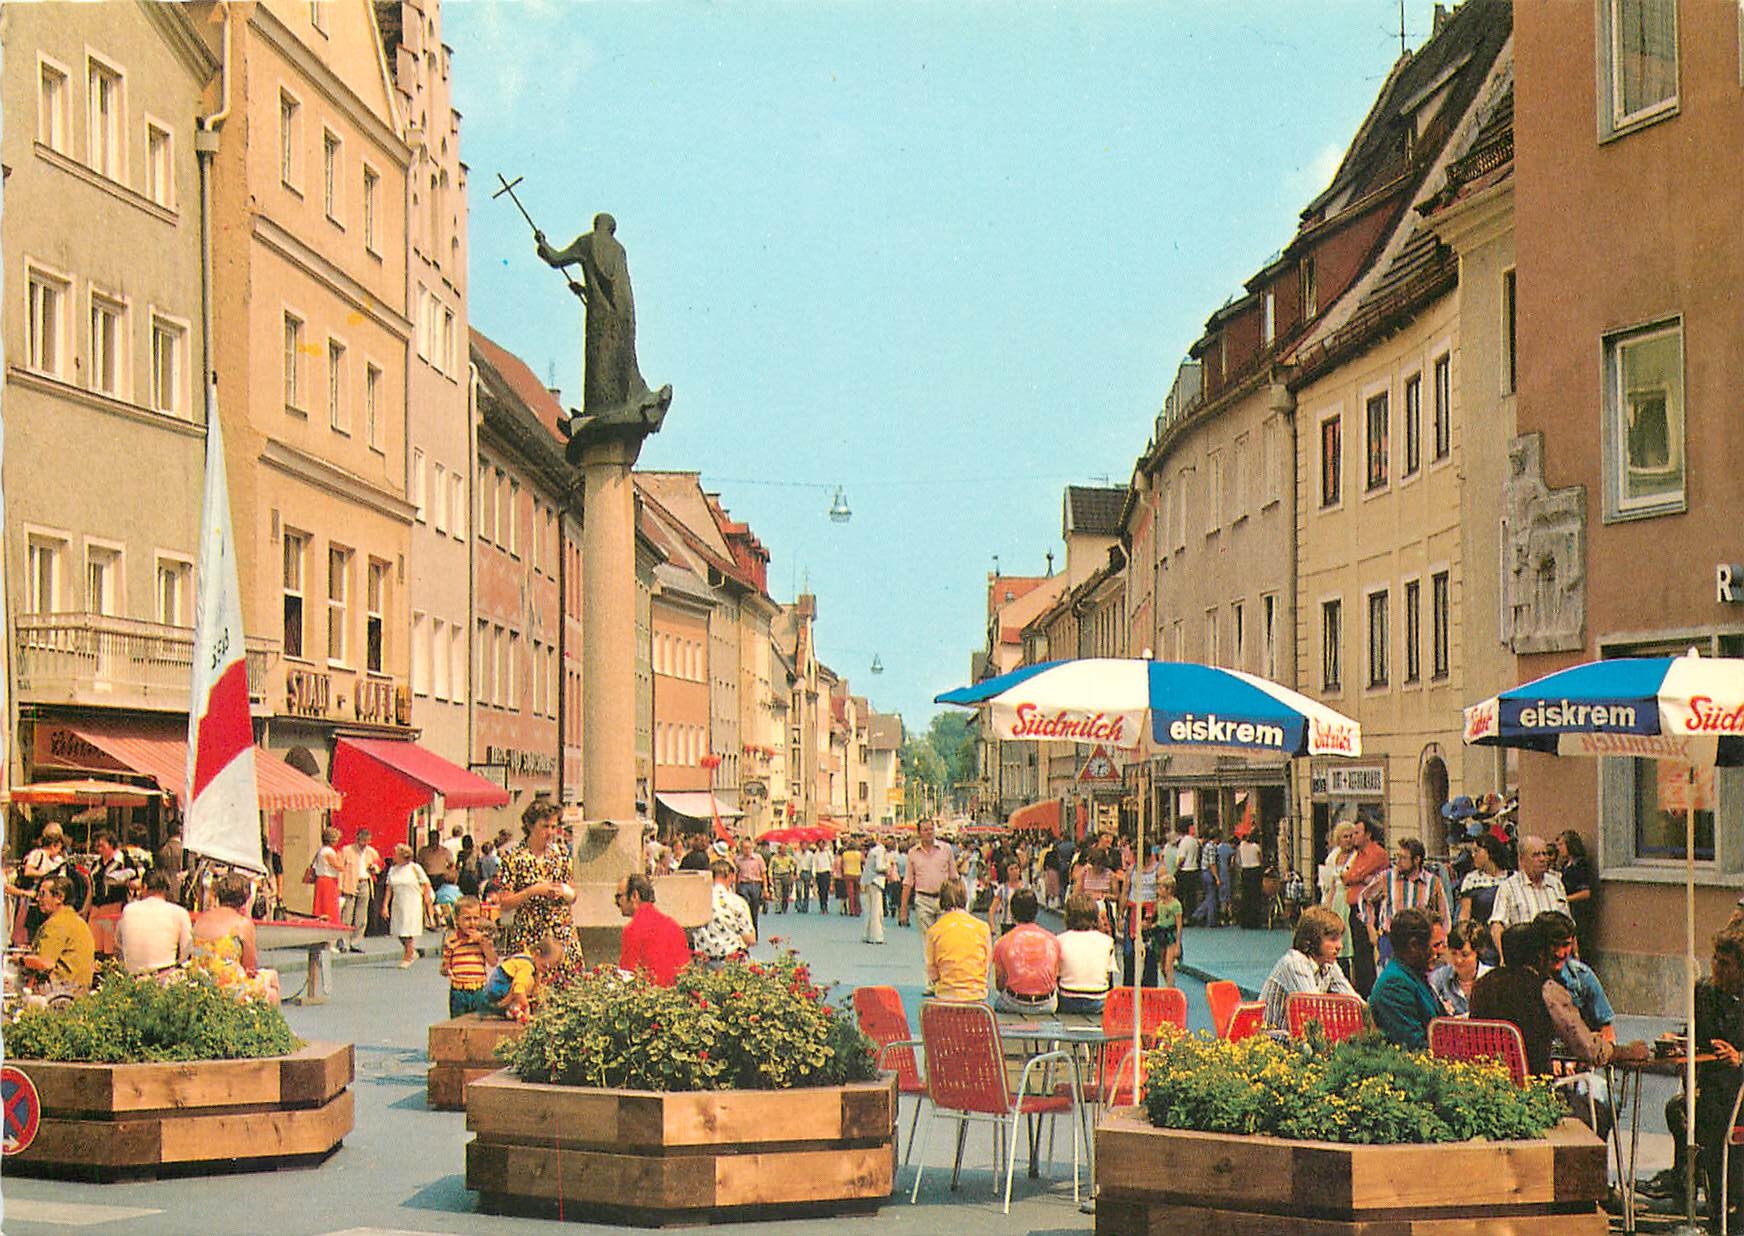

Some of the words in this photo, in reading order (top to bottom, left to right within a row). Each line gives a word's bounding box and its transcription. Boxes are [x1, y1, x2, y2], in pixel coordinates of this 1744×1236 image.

[1011, 702, 1124, 741] Südmilch
[1520, 699, 1636, 728] eiskrem
[1170, 714, 1284, 747] eiskrem
